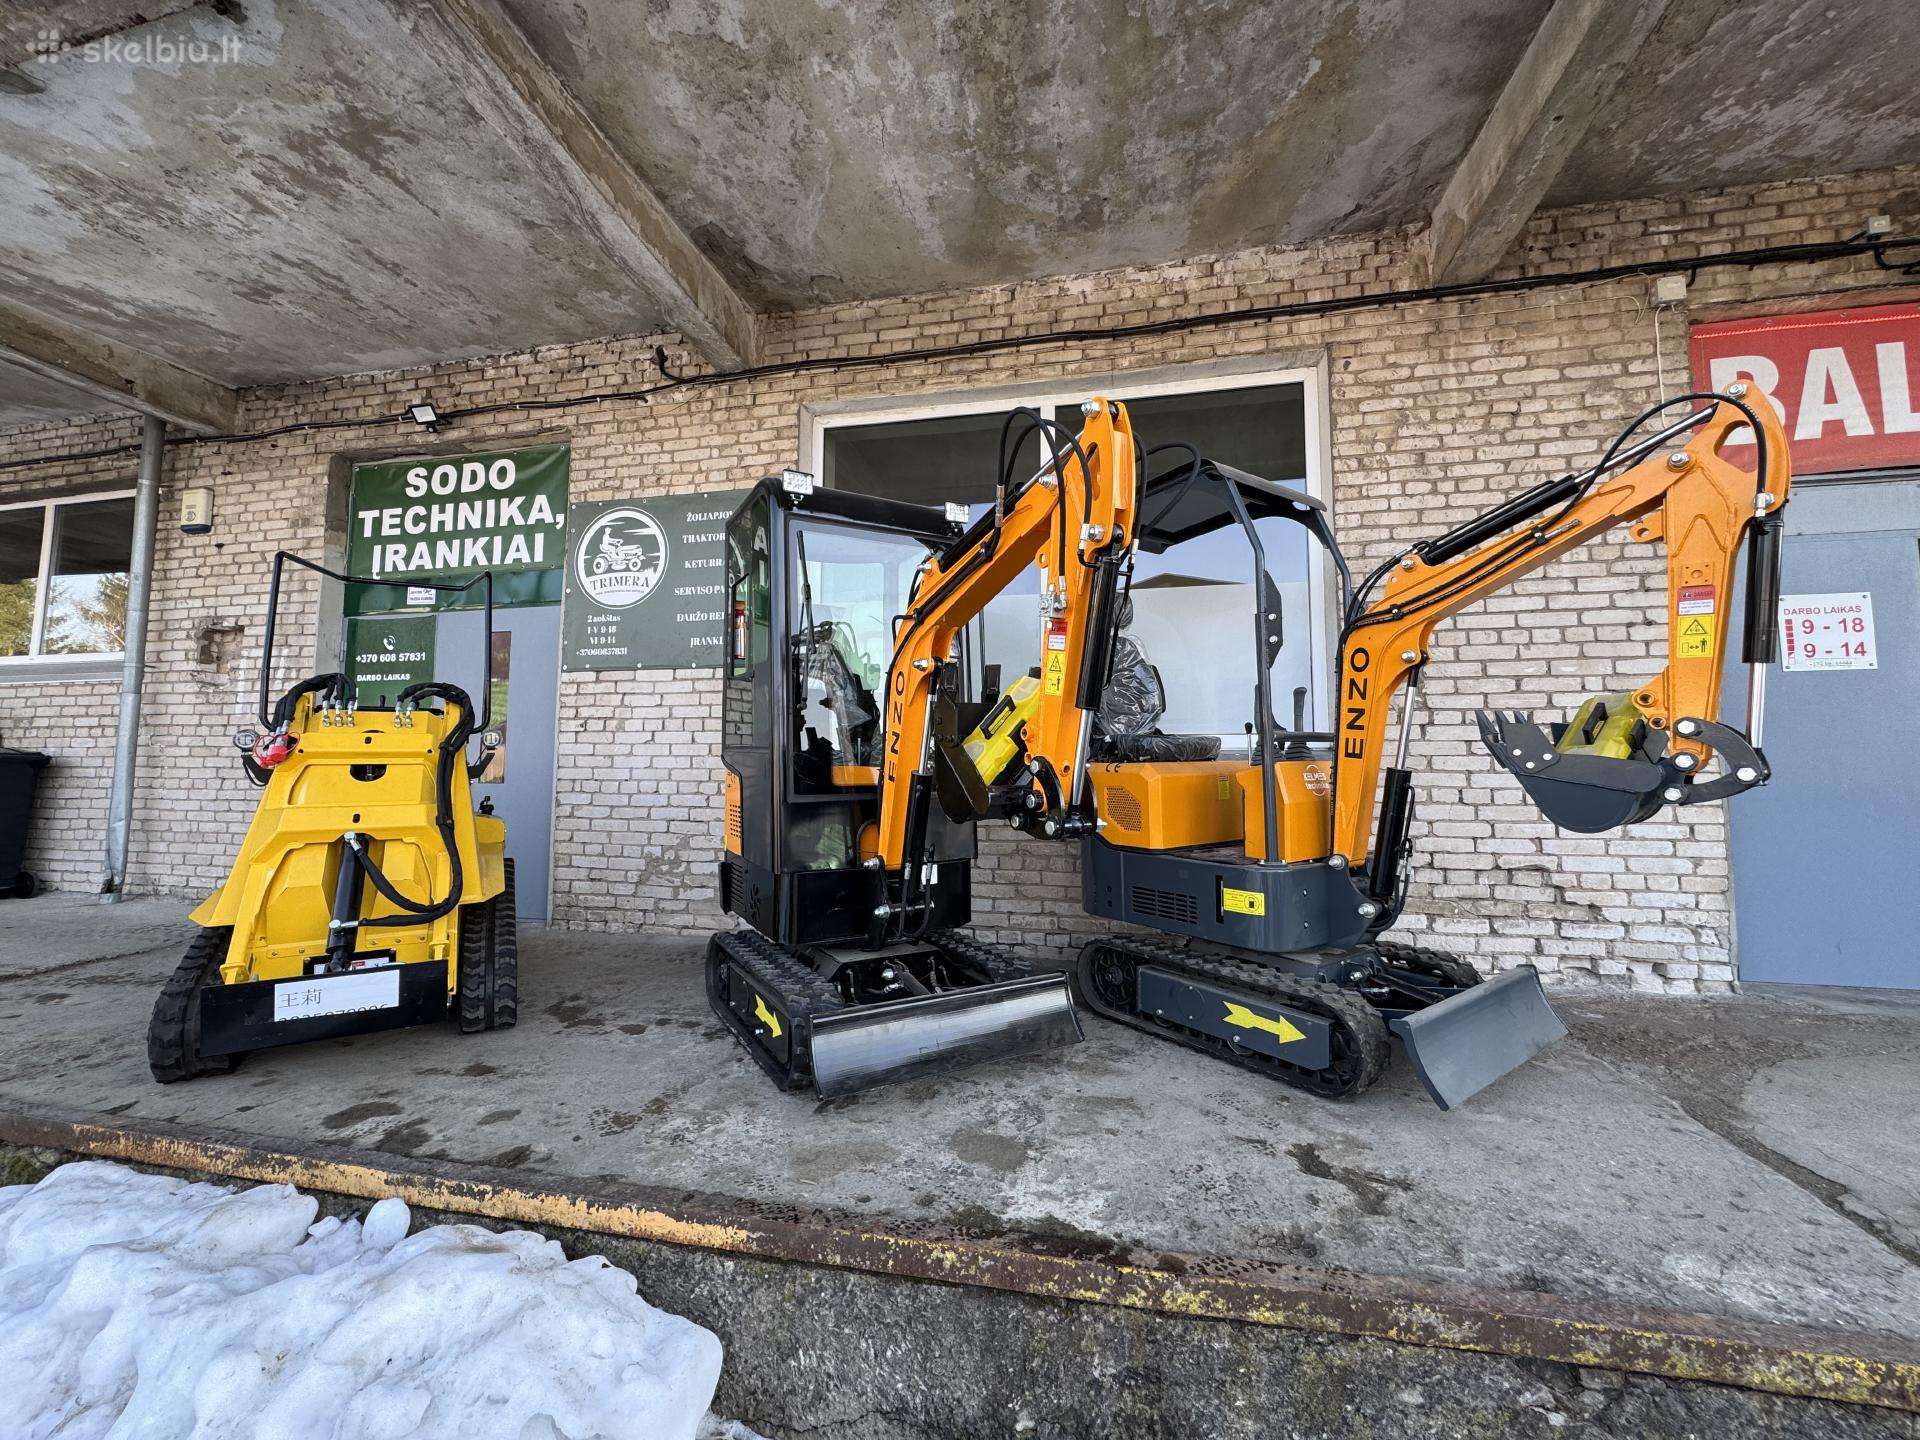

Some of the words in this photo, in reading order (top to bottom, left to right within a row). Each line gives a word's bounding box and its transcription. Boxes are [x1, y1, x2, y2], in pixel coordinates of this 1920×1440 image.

[405, 458, 516, 497] SODO
[358, 494, 565, 538] TECHNIKA,
[371, 532, 545, 580] ĮRANKIAI
[590, 575, 649, 590] TRIMERA
[674, 585, 712, 596] SERVISO
[587, 614, 593, 623] 2
[676, 610, 707, 622] DARŽO
[1784, 607, 1821, 615] DARBO
[1824, 605, 1862, 614] LAIKAS
[1801, 619, 1815, 634] 9
[1838, 617, 1864, 633] 18
[355, 653, 378, 663] +370
[380, 653, 396, 663] 608
[398, 651, 426, 662] 57831
[1803, 643, 1816, 658] 9
[1841, 641, 1867, 657] 14
[356, 674, 382, 682] DARBO
[383, 673, 411, 681] LAIKAS
[1344, 647, 1370, 760] ENZO
[888, 671, 905, 784] ENZO
[278, 988, 323, 1008] 王莉
